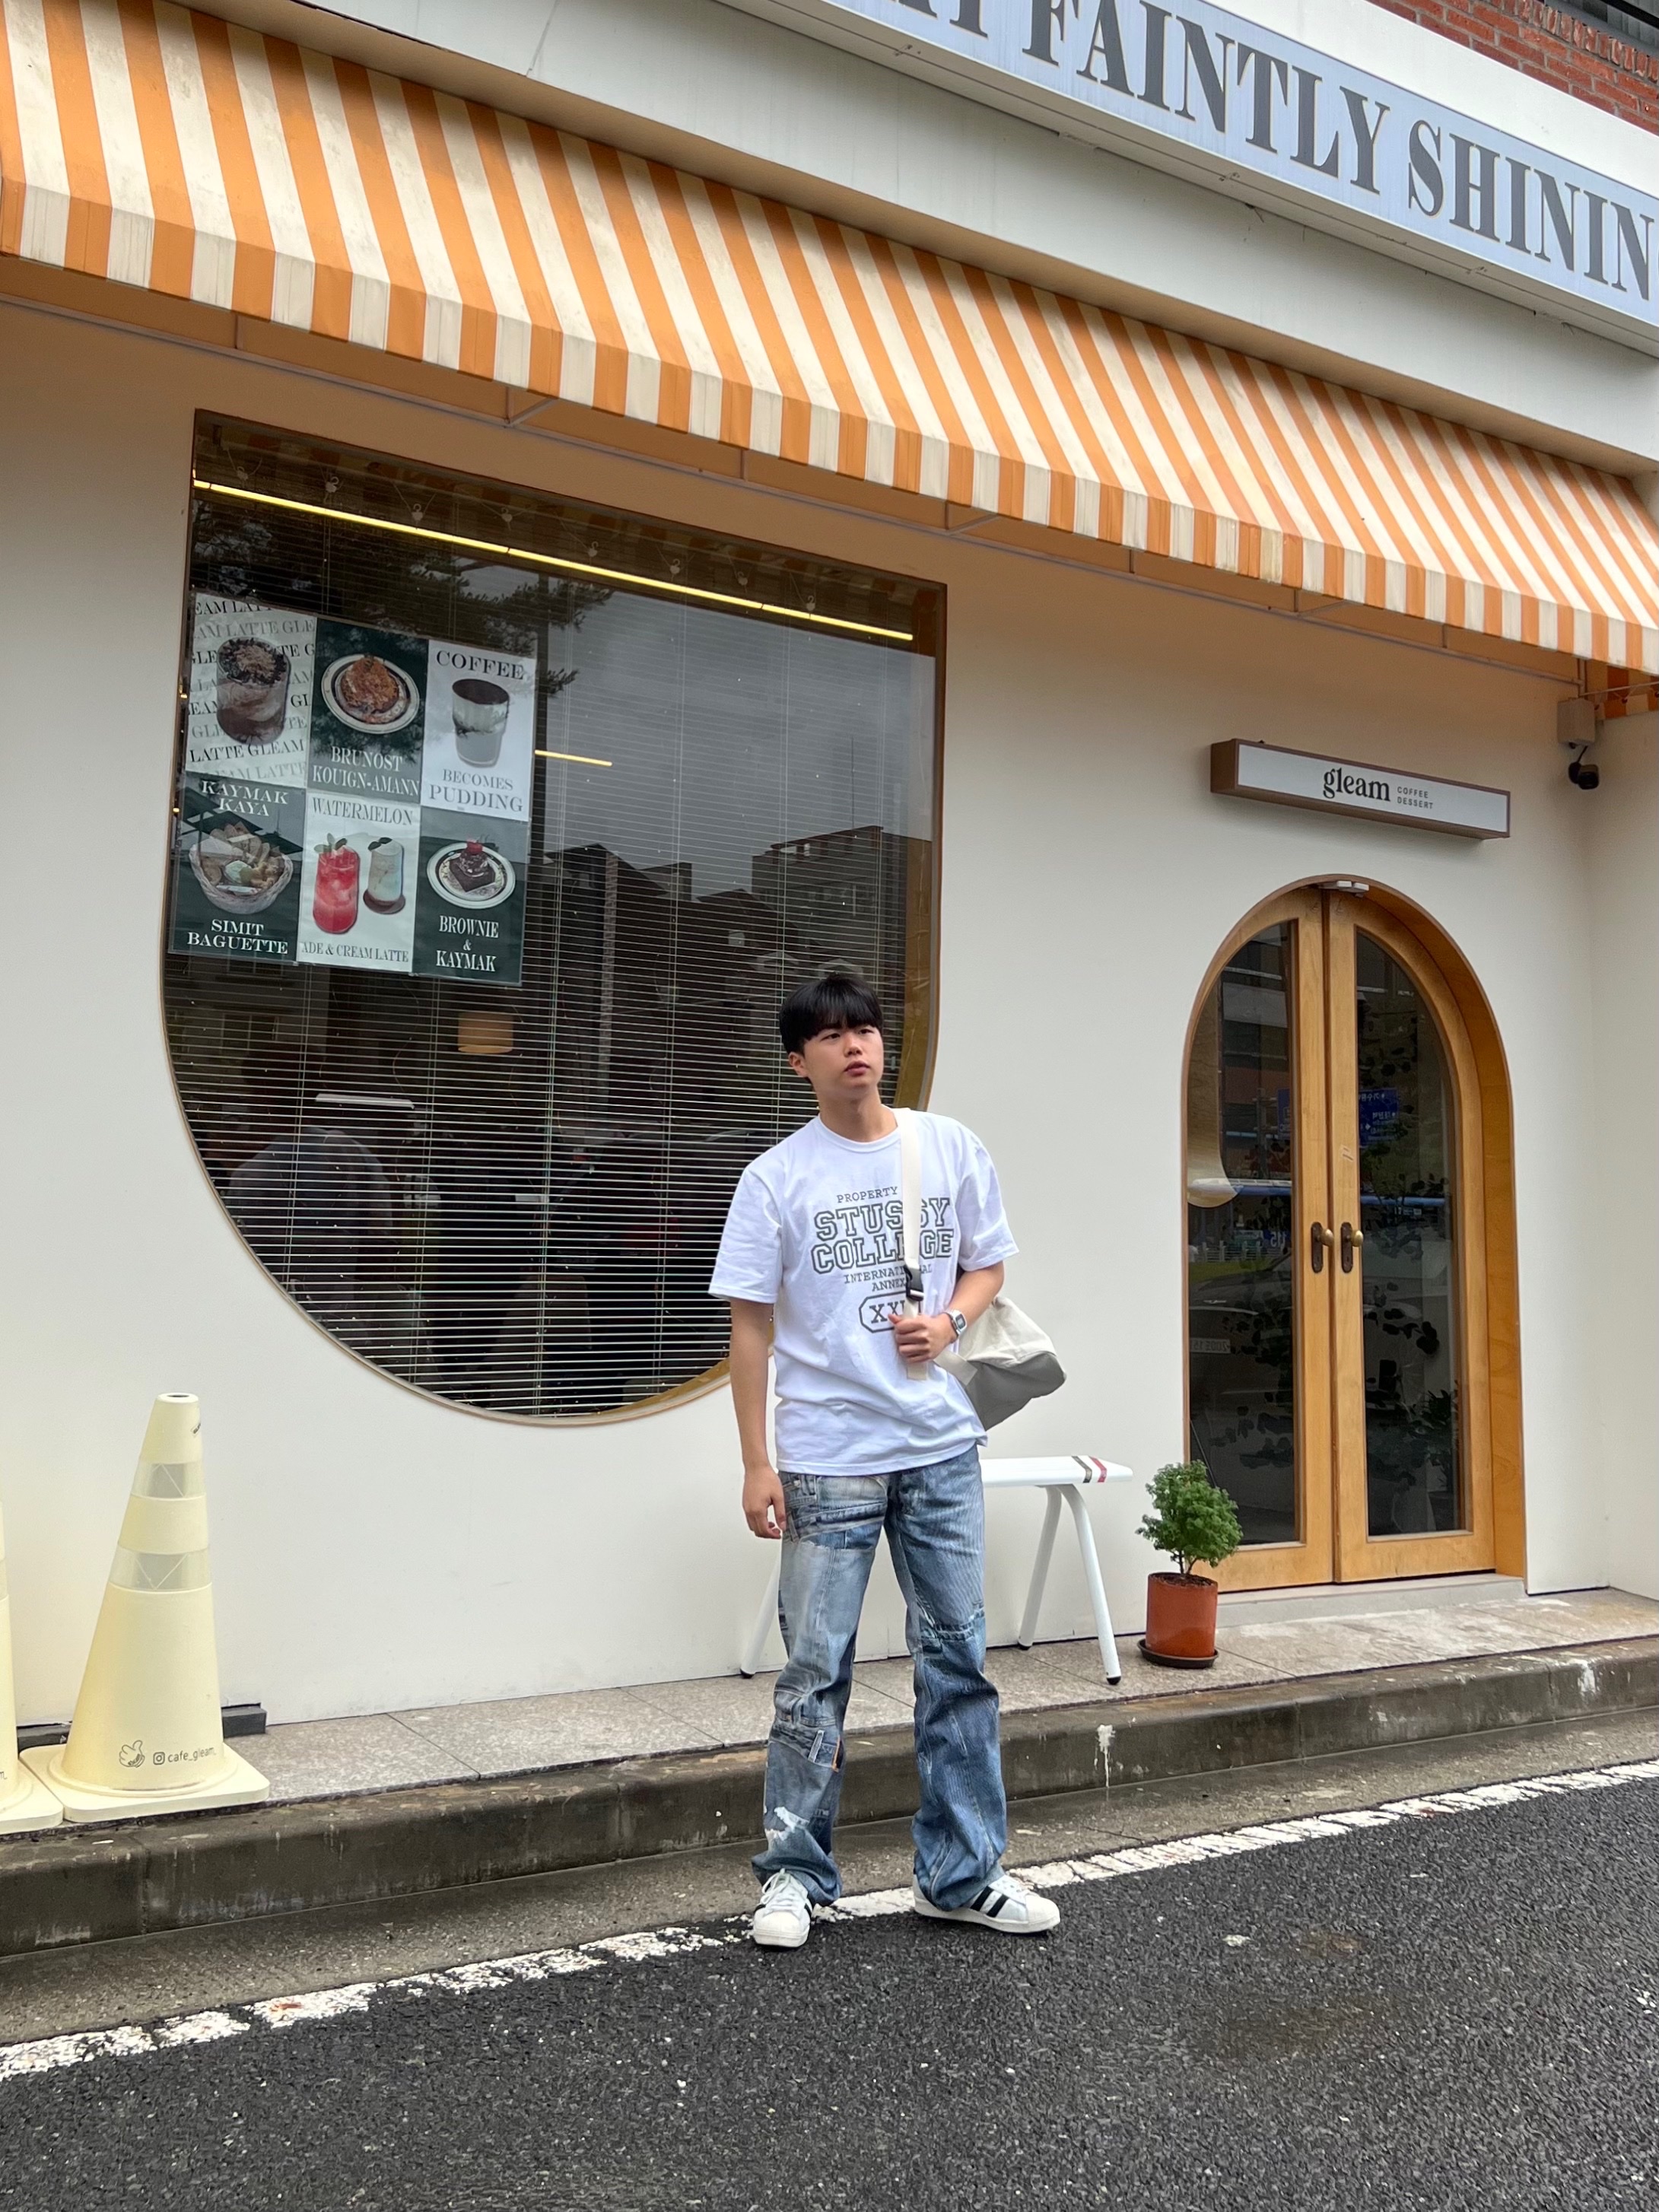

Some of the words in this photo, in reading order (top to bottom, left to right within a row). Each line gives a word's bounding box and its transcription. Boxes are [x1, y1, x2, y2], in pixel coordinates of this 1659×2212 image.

[1022, 0, 1390, 195] FAINTLY
[1408, 119, 1659, 301] SHININ
[225, 621, 279, 637] LATTE
[436, 650, 525, 680] COFFEE
[190, 745, 244, 763] LATTE
[247, 739, 304, 757] GLEAM
[331, 745, 403, 772] BRUNOST
[312, 765, 420, 796] KOUIGN-AMANN
[442, 769, 514, 791] BECOMES
[1323, 767, 1391, 802] gleam
[202, 780, 289, 805] KAYMAK
[429, 784, 523, 812] PUDDING
[1397, 786, 1429, 799] COFFEE
[1397, 796, 1434, 809] DESSERT
[218, 798, 270, 817] KAYA
[312, 797, 414, 826] WATERMELON
[211, 919, 265, 936] SIMIT
[439, 915, 499, 939] BROWNIE
[187, 932, 288, 955] BAGUETTE
[301, 941, 324, 954] ADE
[325, 943, 334, 955] &
[336, 944, 373, 959] CREAM
[375, 948, 409, 963] LATTE
[462, 939, 472, 951] &
[436, 950, 497, 972] KAYMAK
[836, 1186, 898, 1203] PROPERTY
[844, 1263, 933, 1284] INTERNATIAL
[872, 1278, 907, 1292] ANNEX
